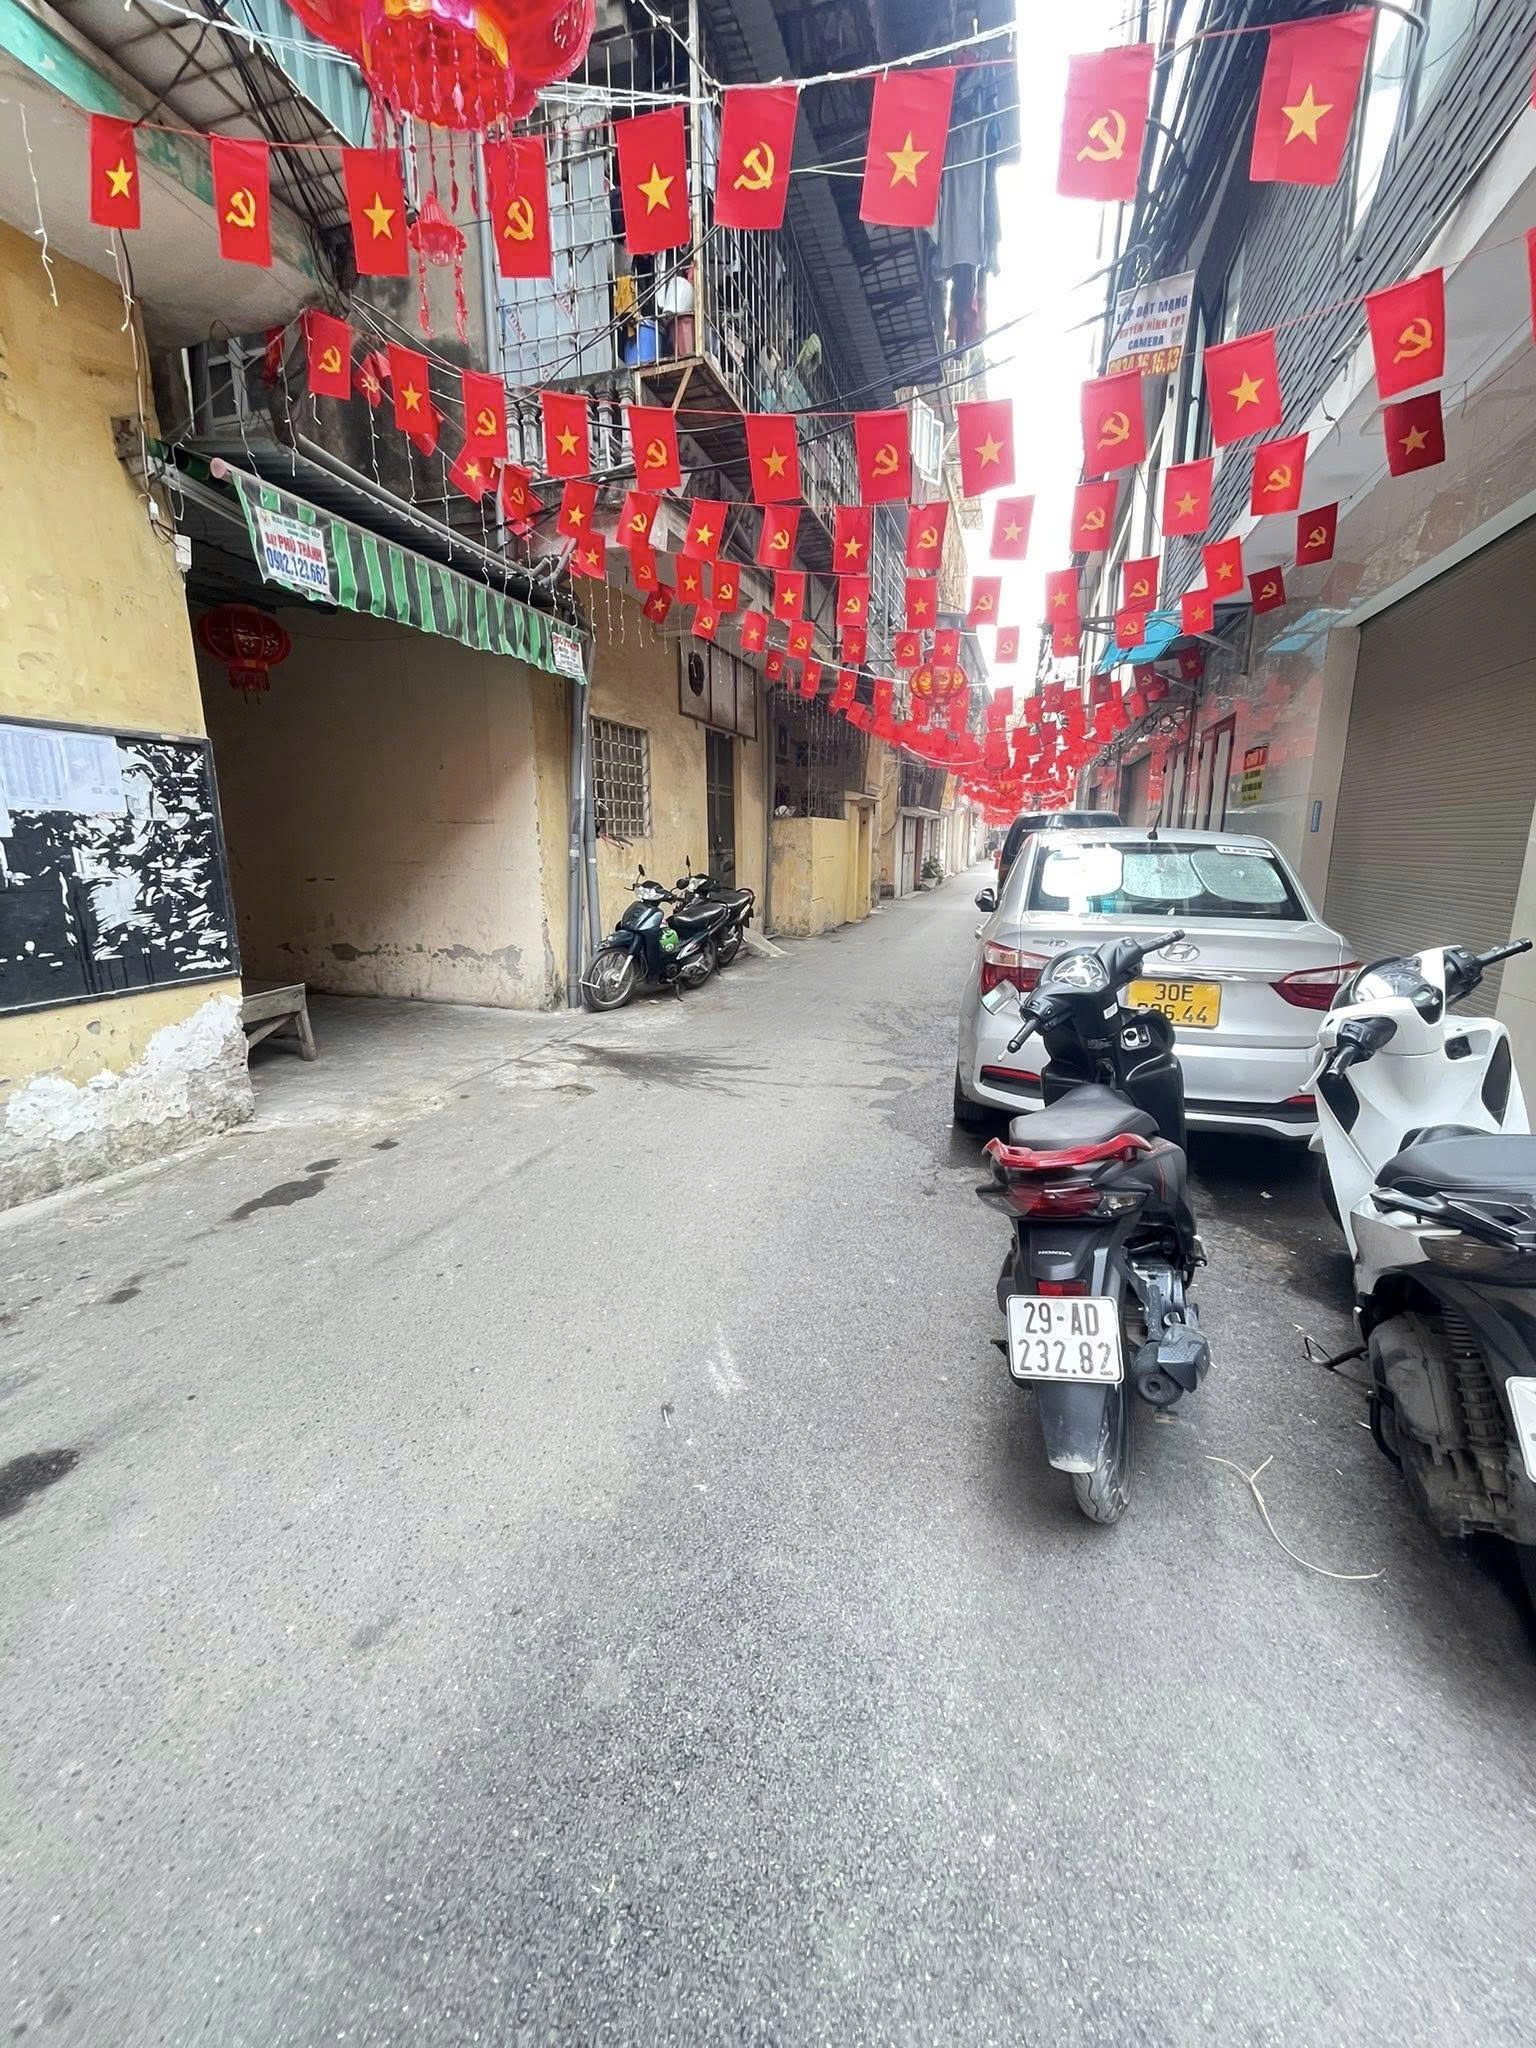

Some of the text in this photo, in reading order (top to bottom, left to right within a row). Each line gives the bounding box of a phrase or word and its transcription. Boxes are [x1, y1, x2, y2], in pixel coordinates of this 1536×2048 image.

[1158, 295, 1188, 314] MẠNG
[1128, 335, 1164, 350] CAMERA
[1154, 983, 1194, 1002] 30E
[1137, 1002, 1208, 1023] 6.44
[1023, 1301, 1100, 1336] 29-AD
[1018, 1339, 1114, 1376] 232.82
